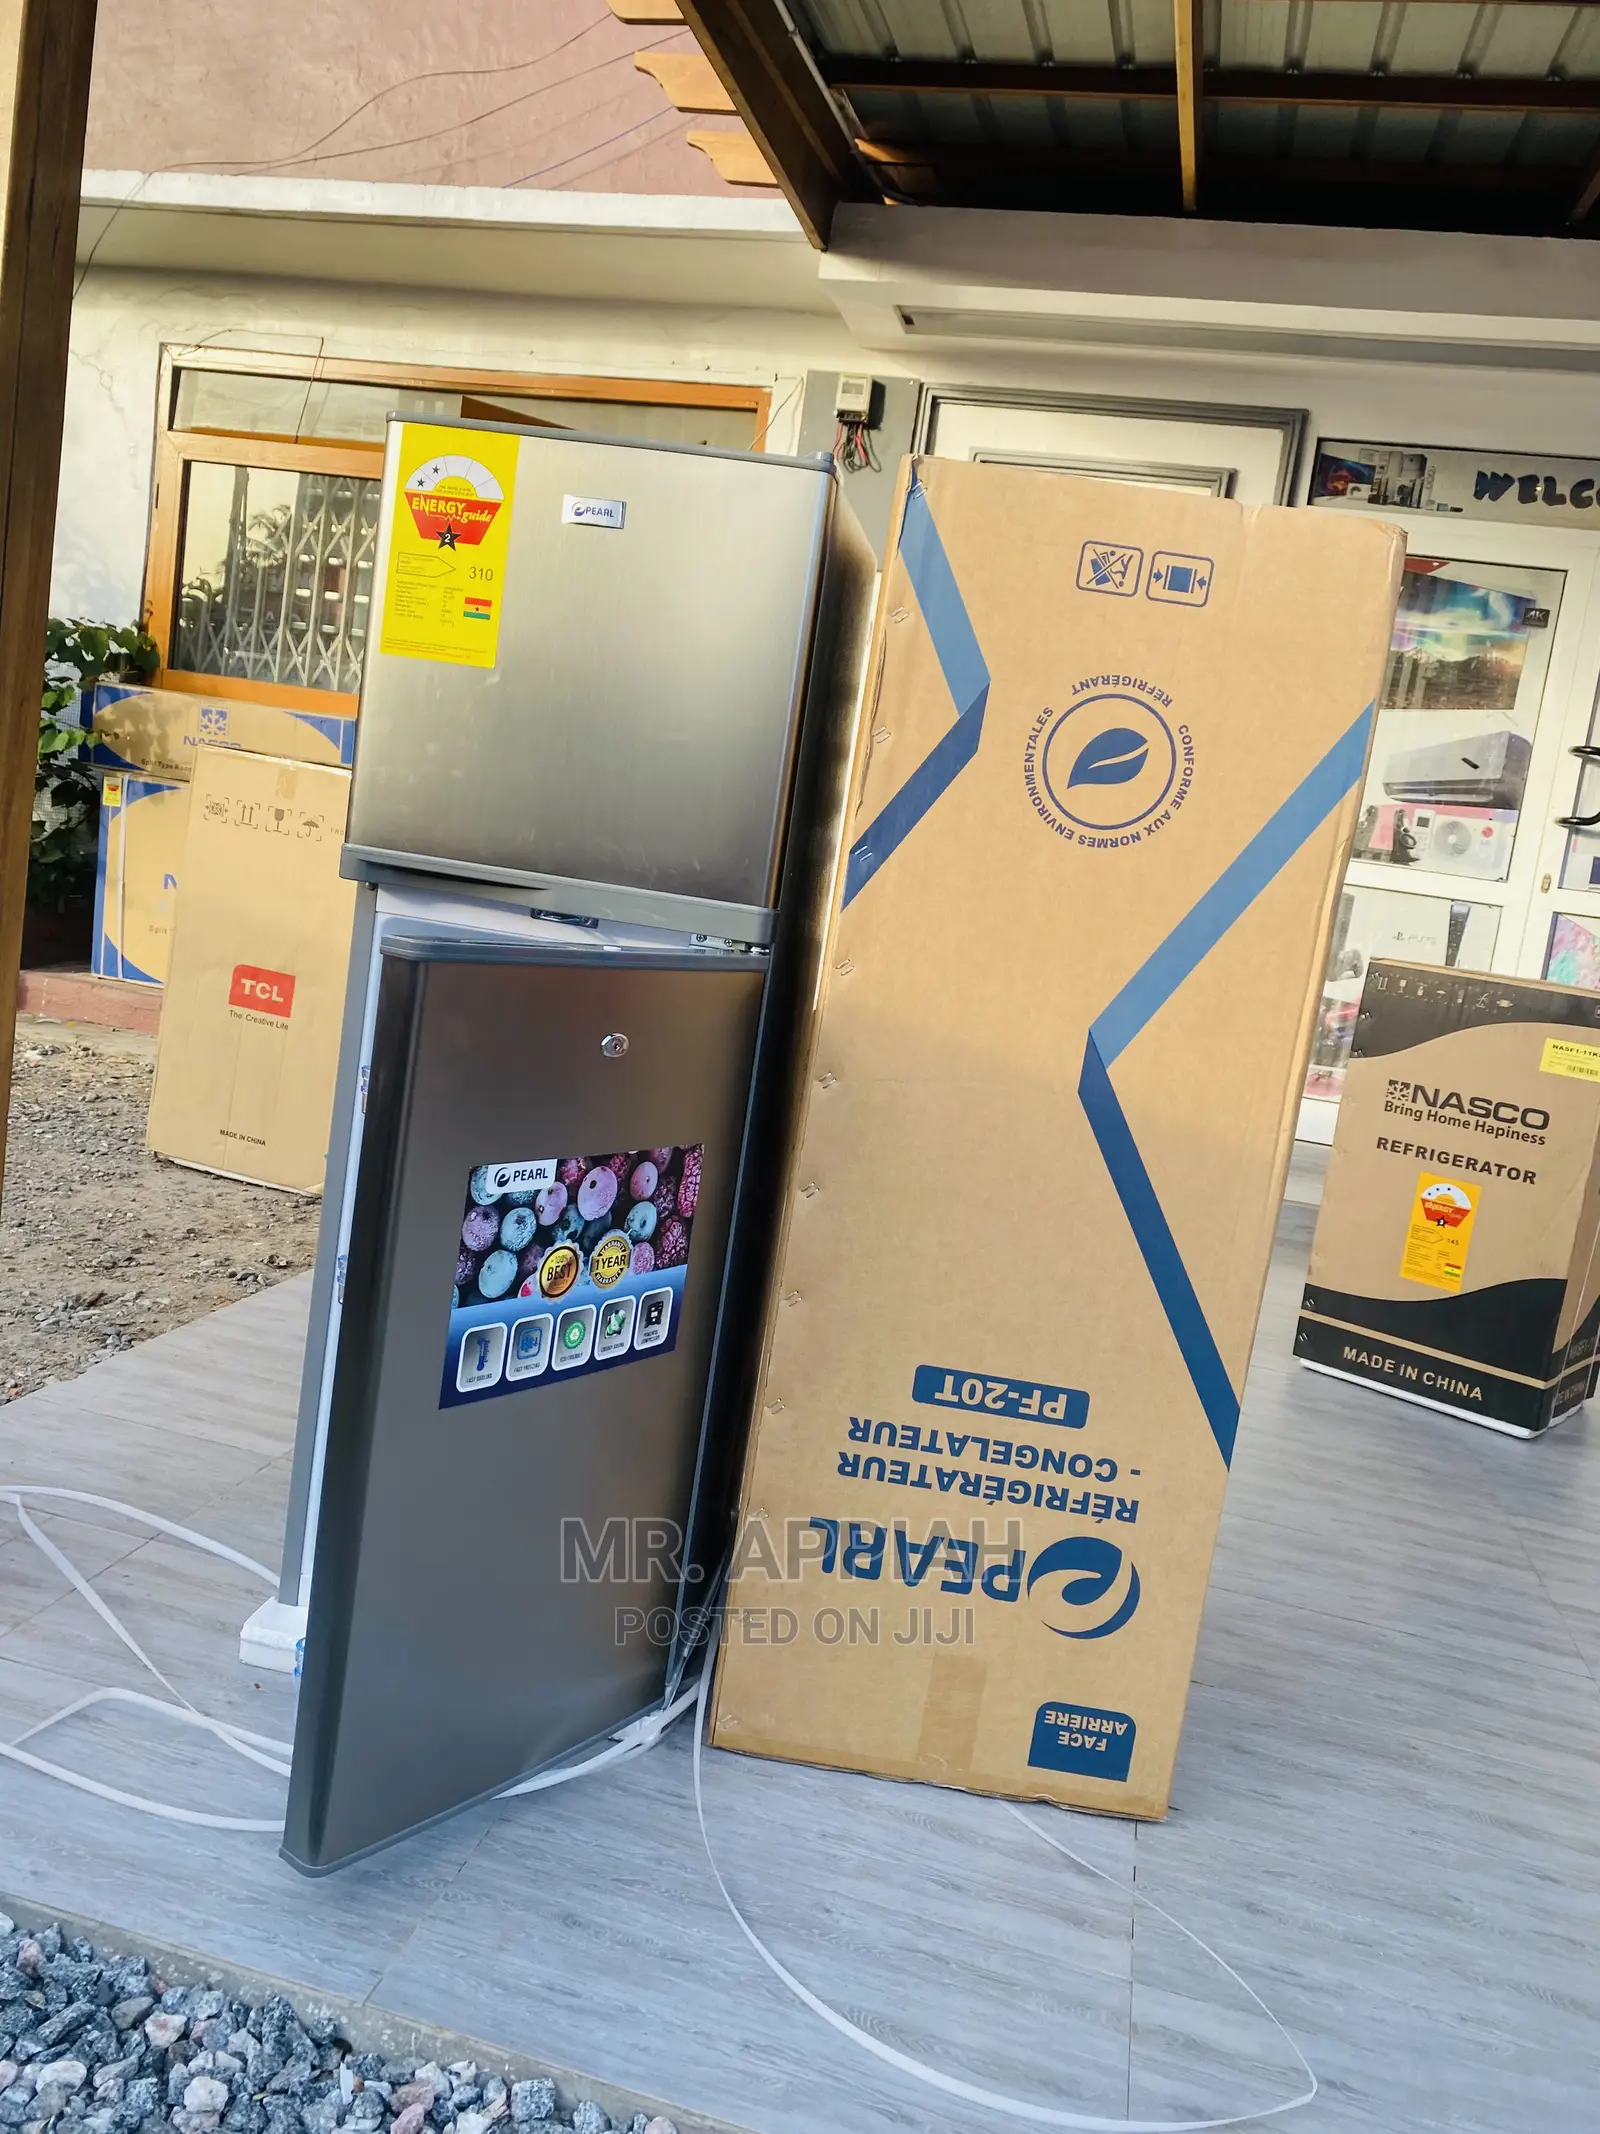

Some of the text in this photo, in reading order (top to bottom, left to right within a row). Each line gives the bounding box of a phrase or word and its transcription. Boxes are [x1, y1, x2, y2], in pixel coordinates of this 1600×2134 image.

[412, 494, 492, 524] ENERGY guide
[585, 506, 615, 518] PEARL
[444, 533, 451, 543] 2
[469, 566, 494, 582] 310
[1071, 675, 1173, 708] RÉFRIGÉRANT
[1023, 707, 1195, 849] CONFORME AUX NORMES ENVIRONMENTALES
[240, 978, 284, 1003] TCL
[229, 1009, 289, 1031] The Creative Life
[1552, 1043, 1600, 1058] NASF1-11K
[1411, 1083, 1550, 1131] NASCO
[1384, 1101, 1546, 1146] Bring Home Hapiness
[219, 1129, 238, 1140] MADE
[246, 1136, 267, 1147] CHINA
[1376, 1136, 1537, 1185] REFRIGERATOR
[512, 1167, 549, 1182] PEARL
[546, 1263, 572, 1282] BEST
[601, 1254, 627, 1270] YEAR
[1343, 1346, 1483, 1401] MADE IN CHINA
[934, 1375, 1068, 1420] PF-20T
[847, 1416, 1118, 1483] CONGELATEUR
[836, 1451, 1140, 1524] RÉFRIGÉRATEUR
[809, 1516, 1026, 1602] PEARL
[1043, 1710, 1128, 1736] ARRIÈRE
[1057, 1730, 1108, 1752] FACE
